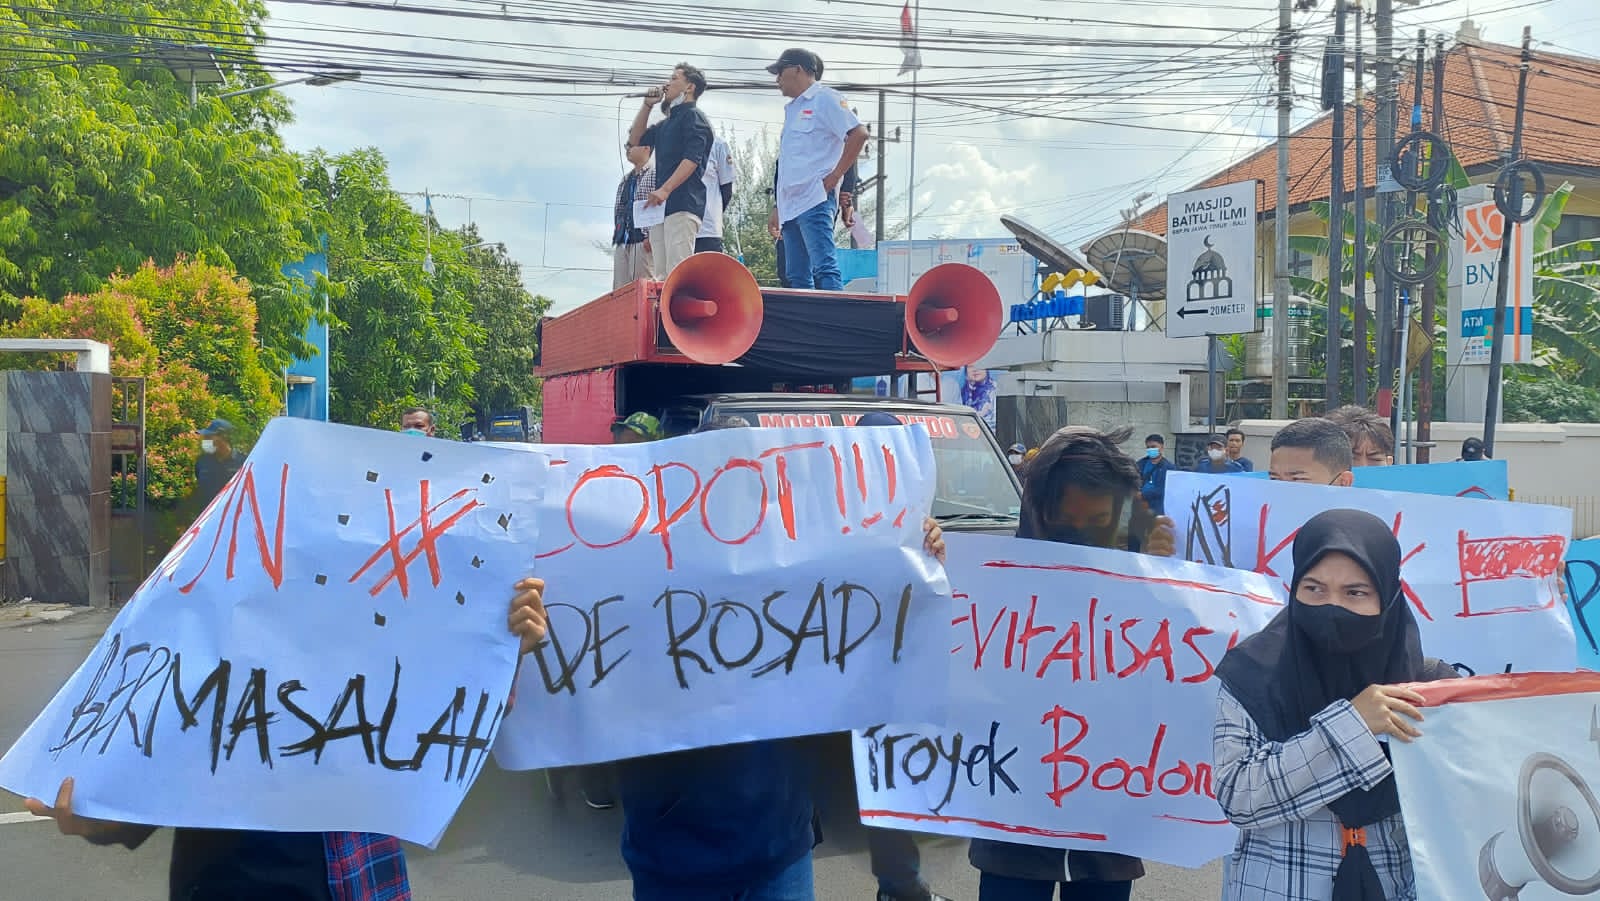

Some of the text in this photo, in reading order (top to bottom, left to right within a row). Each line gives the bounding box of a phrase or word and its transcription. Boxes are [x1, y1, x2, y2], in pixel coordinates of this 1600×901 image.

[1172, 207, 1247, 228] BAITUL ILMI
[1184, 196, 1233, 214] MASJID
[1466, 261, 1495, 285] BN
[1463, 316, 1484, 328] ATM
[653, 577, 913, 690] ROSADI
[951, 590, 1240, 683] EVItAliSASi
[48, 632, 504, 788] BERMASALAH
[1040, 704, 1218, 808] Bodon
